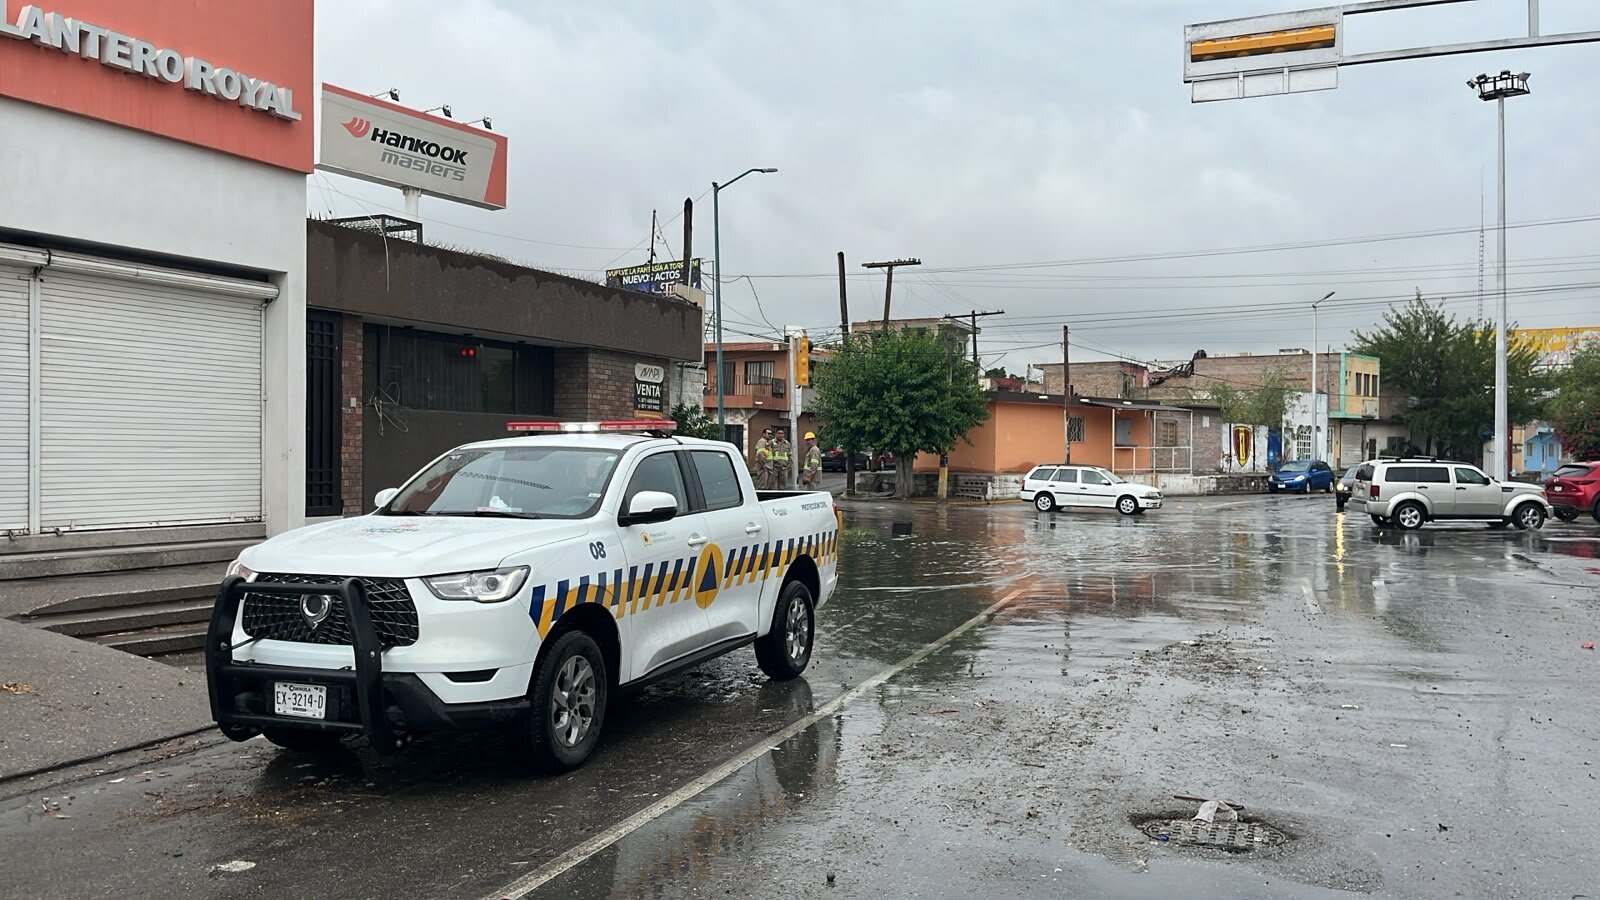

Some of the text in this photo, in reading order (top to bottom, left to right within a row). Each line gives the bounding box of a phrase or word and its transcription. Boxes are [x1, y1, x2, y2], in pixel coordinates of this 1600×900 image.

[184, 56, 302, 122] ROYAL
[380, 150, 467, 182] masters
[655, 270, 680, 281] ACTOS
[636, 383, 661, 397] VENTA
[589, 541, 607, 560] 08
[276, 691, 324, 709] EX-3214-D
